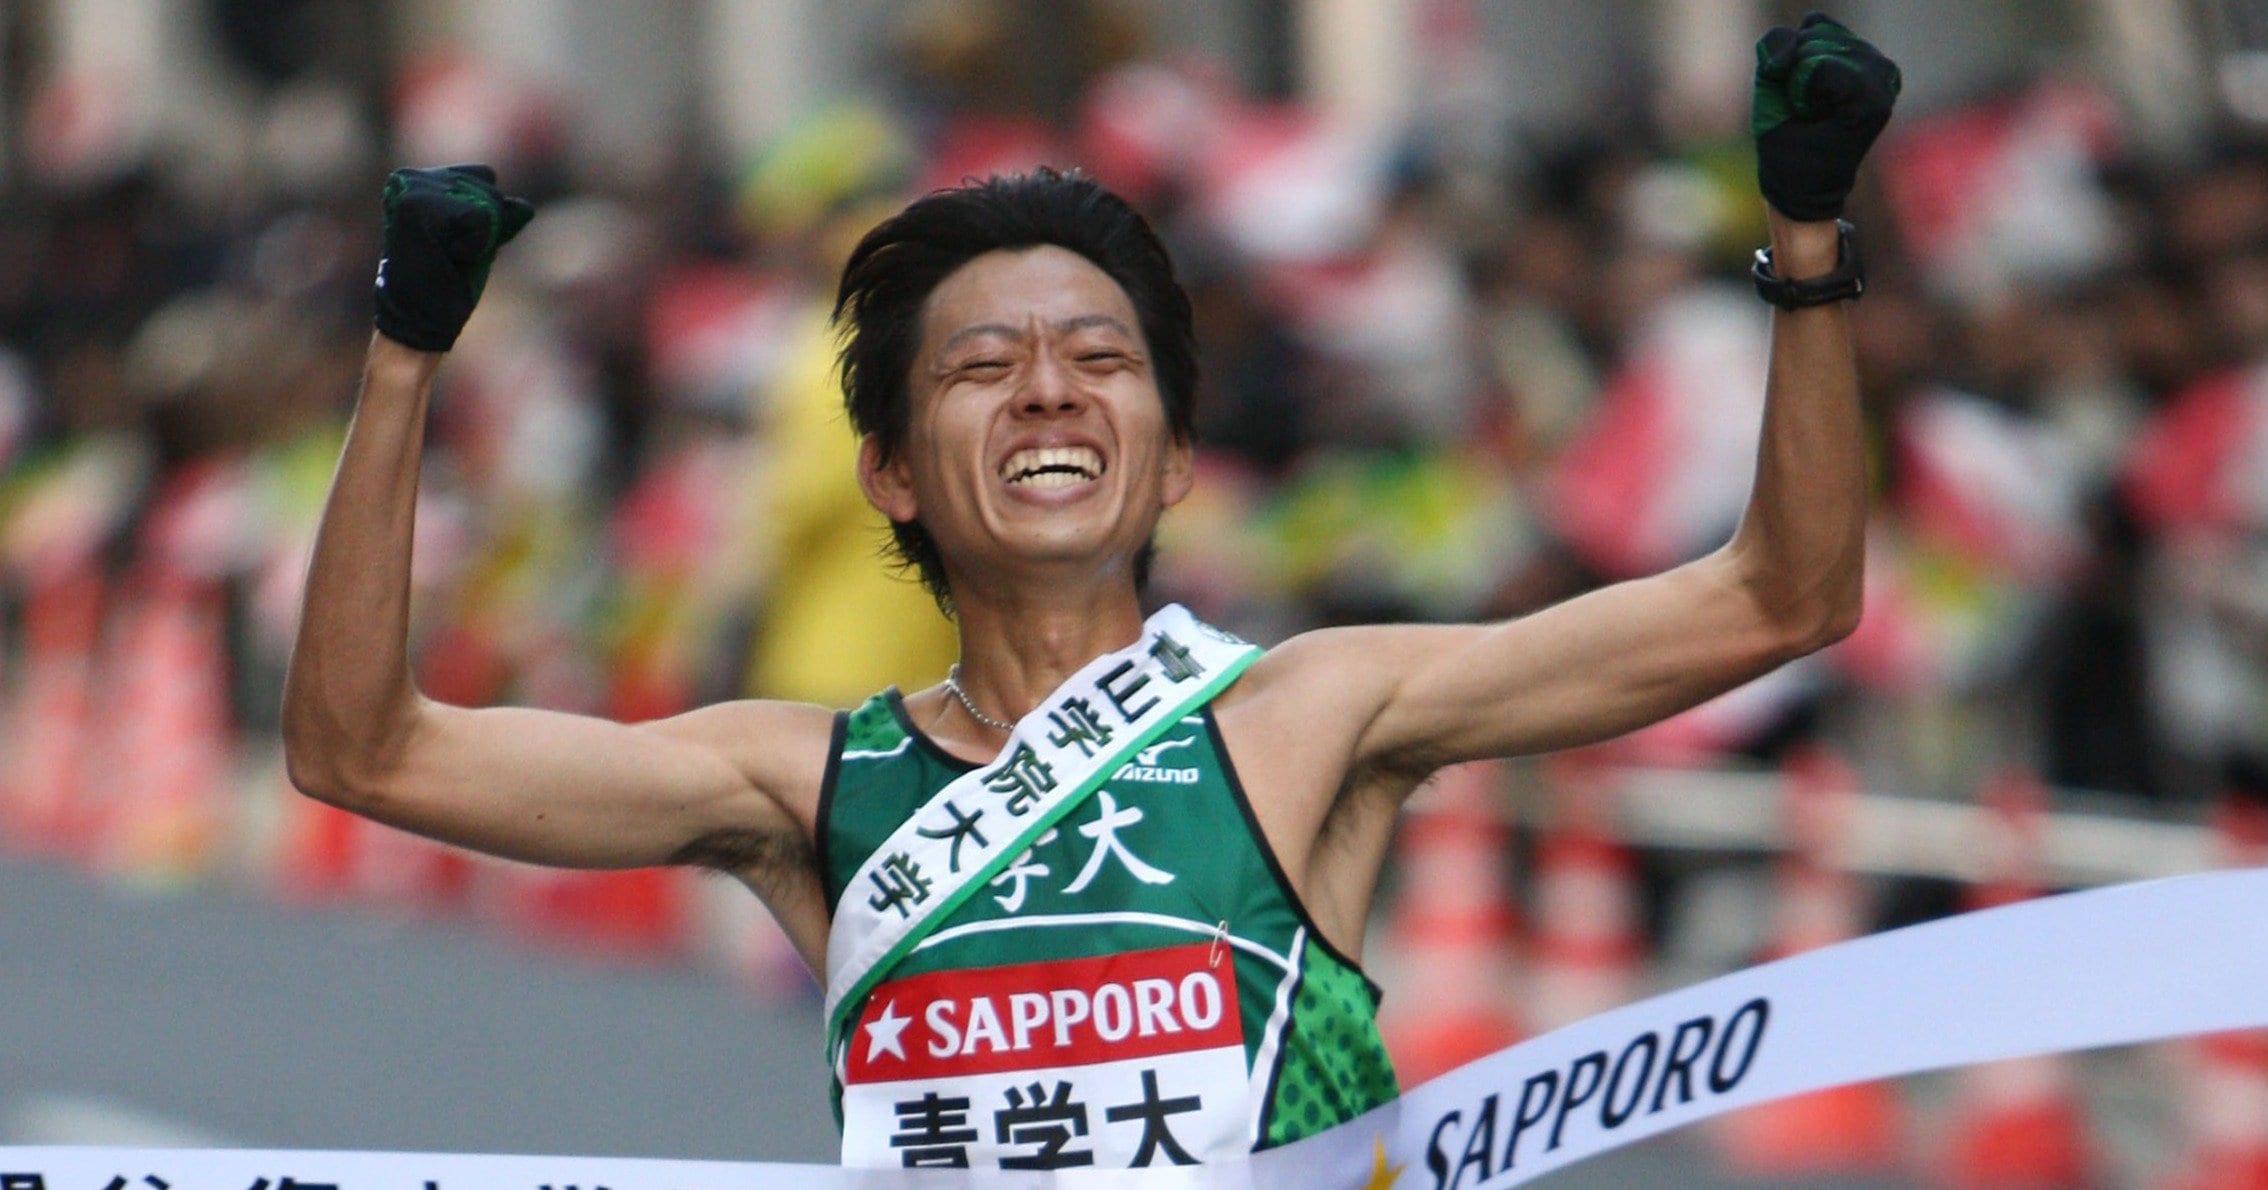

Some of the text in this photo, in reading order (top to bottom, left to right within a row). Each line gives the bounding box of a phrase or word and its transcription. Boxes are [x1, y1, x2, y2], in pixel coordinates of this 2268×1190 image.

[926, 971, 1222, 1058] SAPPORO
[890, 1069, 1203, 1169] 青学大
[1426, 997, 1771, 1190] SAPPORO
